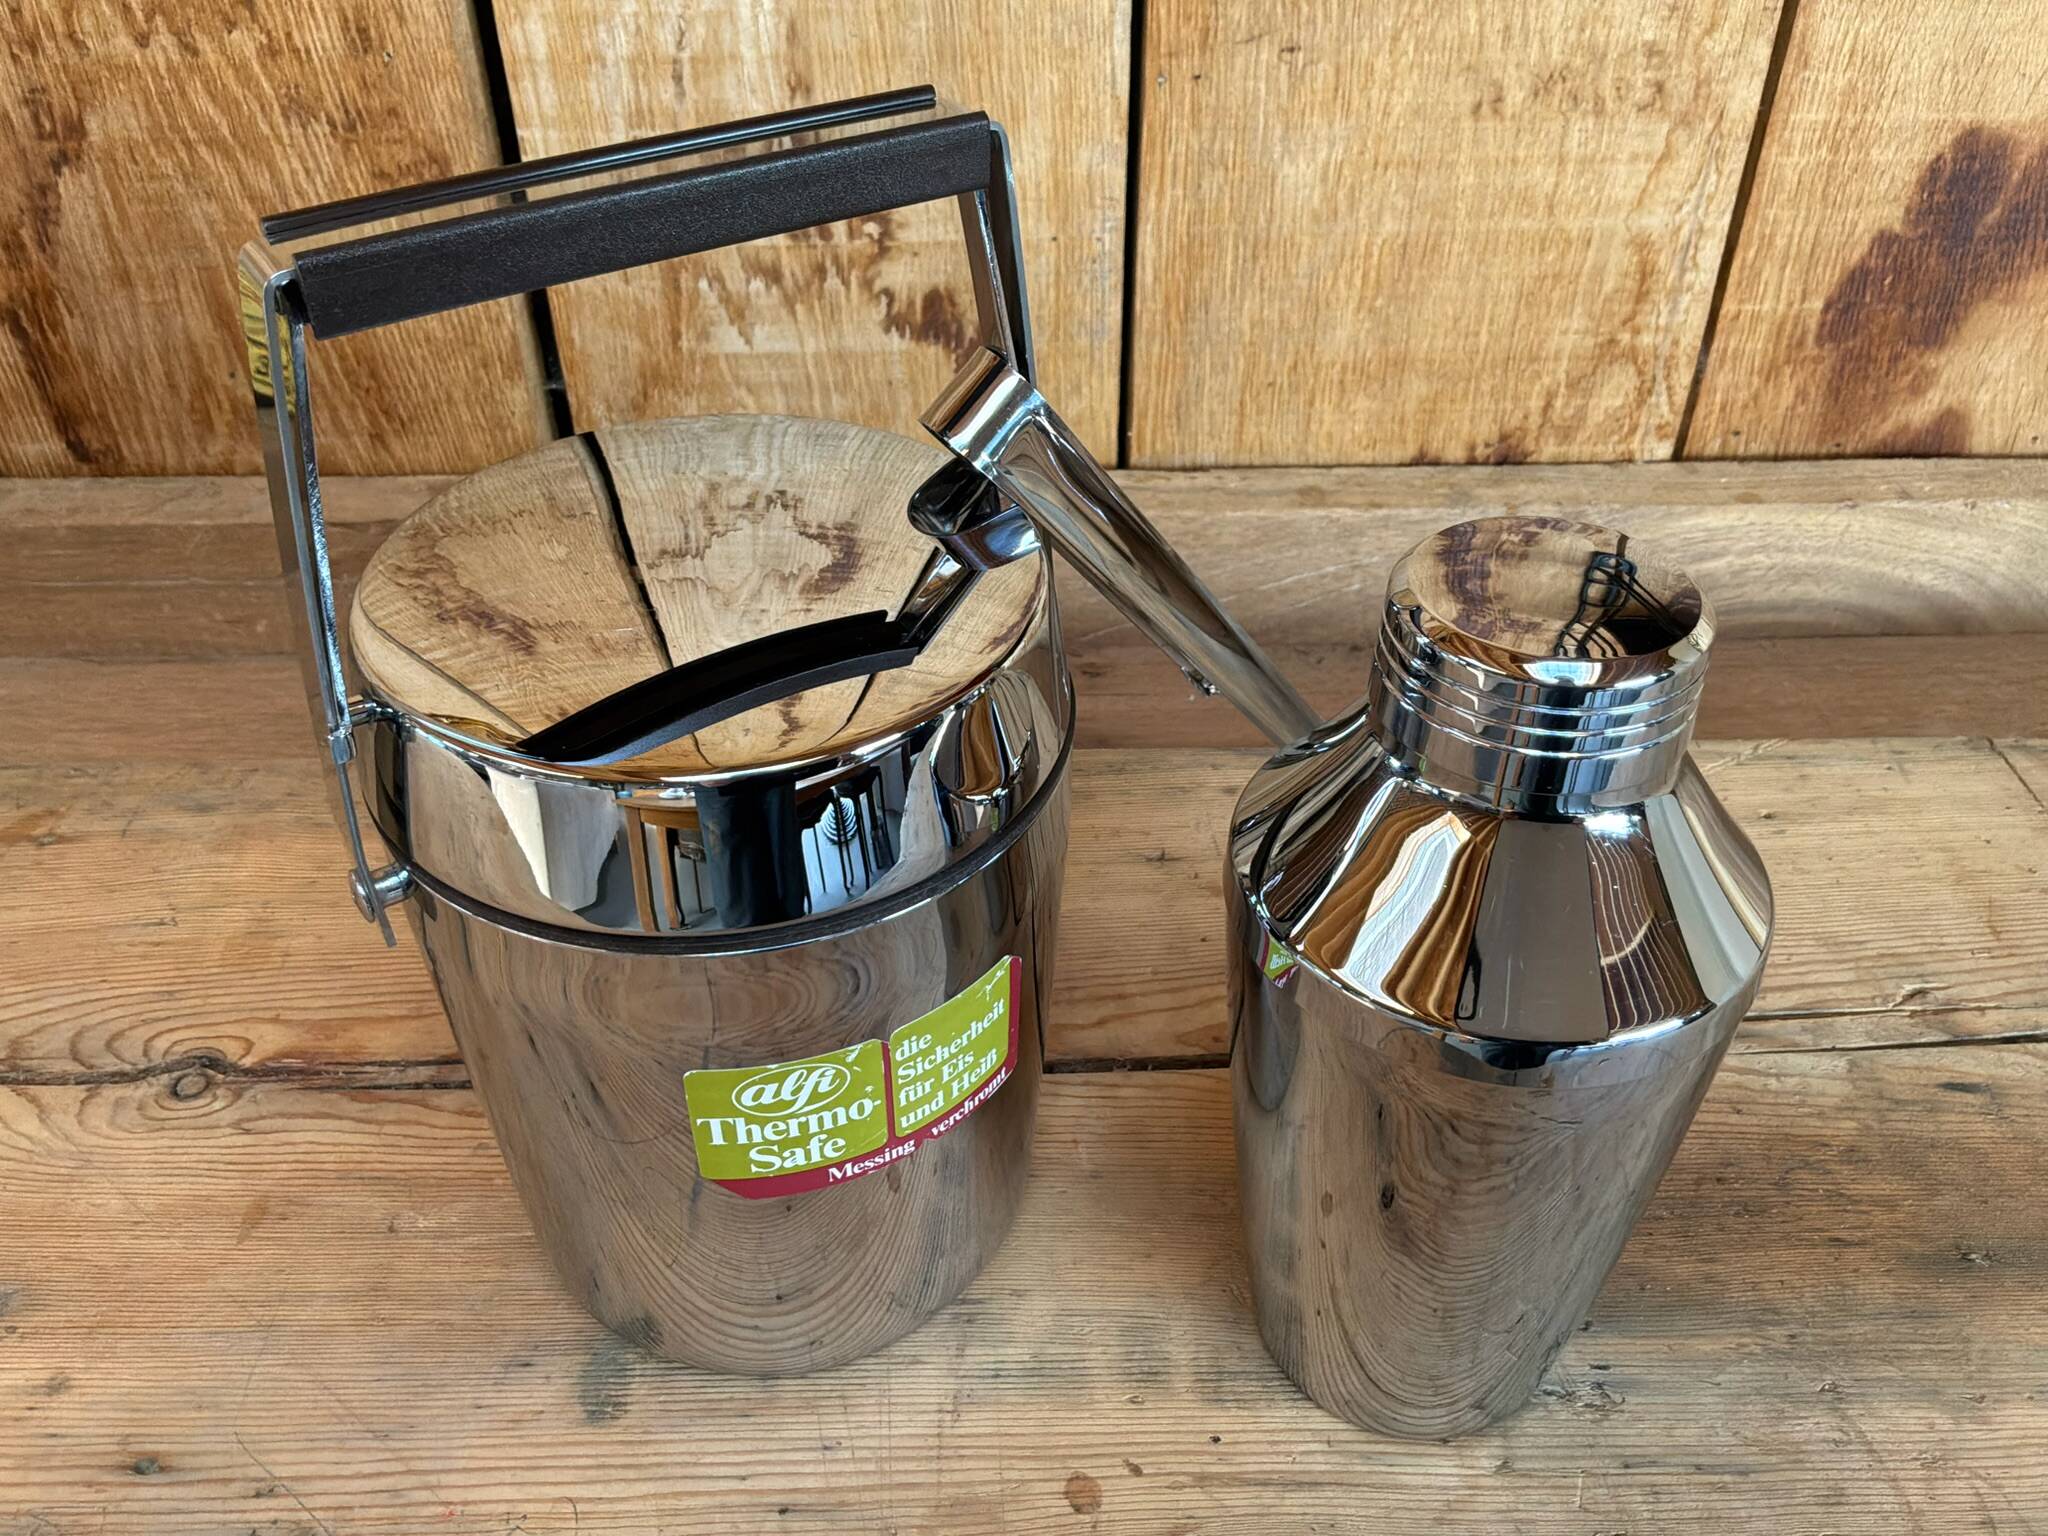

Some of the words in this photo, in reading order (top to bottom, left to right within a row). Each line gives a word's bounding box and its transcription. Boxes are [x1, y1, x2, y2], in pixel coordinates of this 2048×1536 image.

[895, 1033, 932, 1061] die
[897, 998, 1005, 1084] Sicherheit
[740, 1066, 840, 1112] alfi
[899, 1077, 935, 1107] für
[941, 1051, 974, 1083] Eis
[900, 1090, 944, 1128] und
[950, 1048, 998, 1099] Heiß
[696, 1098, 881, 1145] Thermo-
[828, 1138, 916, 1182] Messing
[931, 1066, 1007, 1136] verchromt
[749, 1134, 846, 1172] Safe
